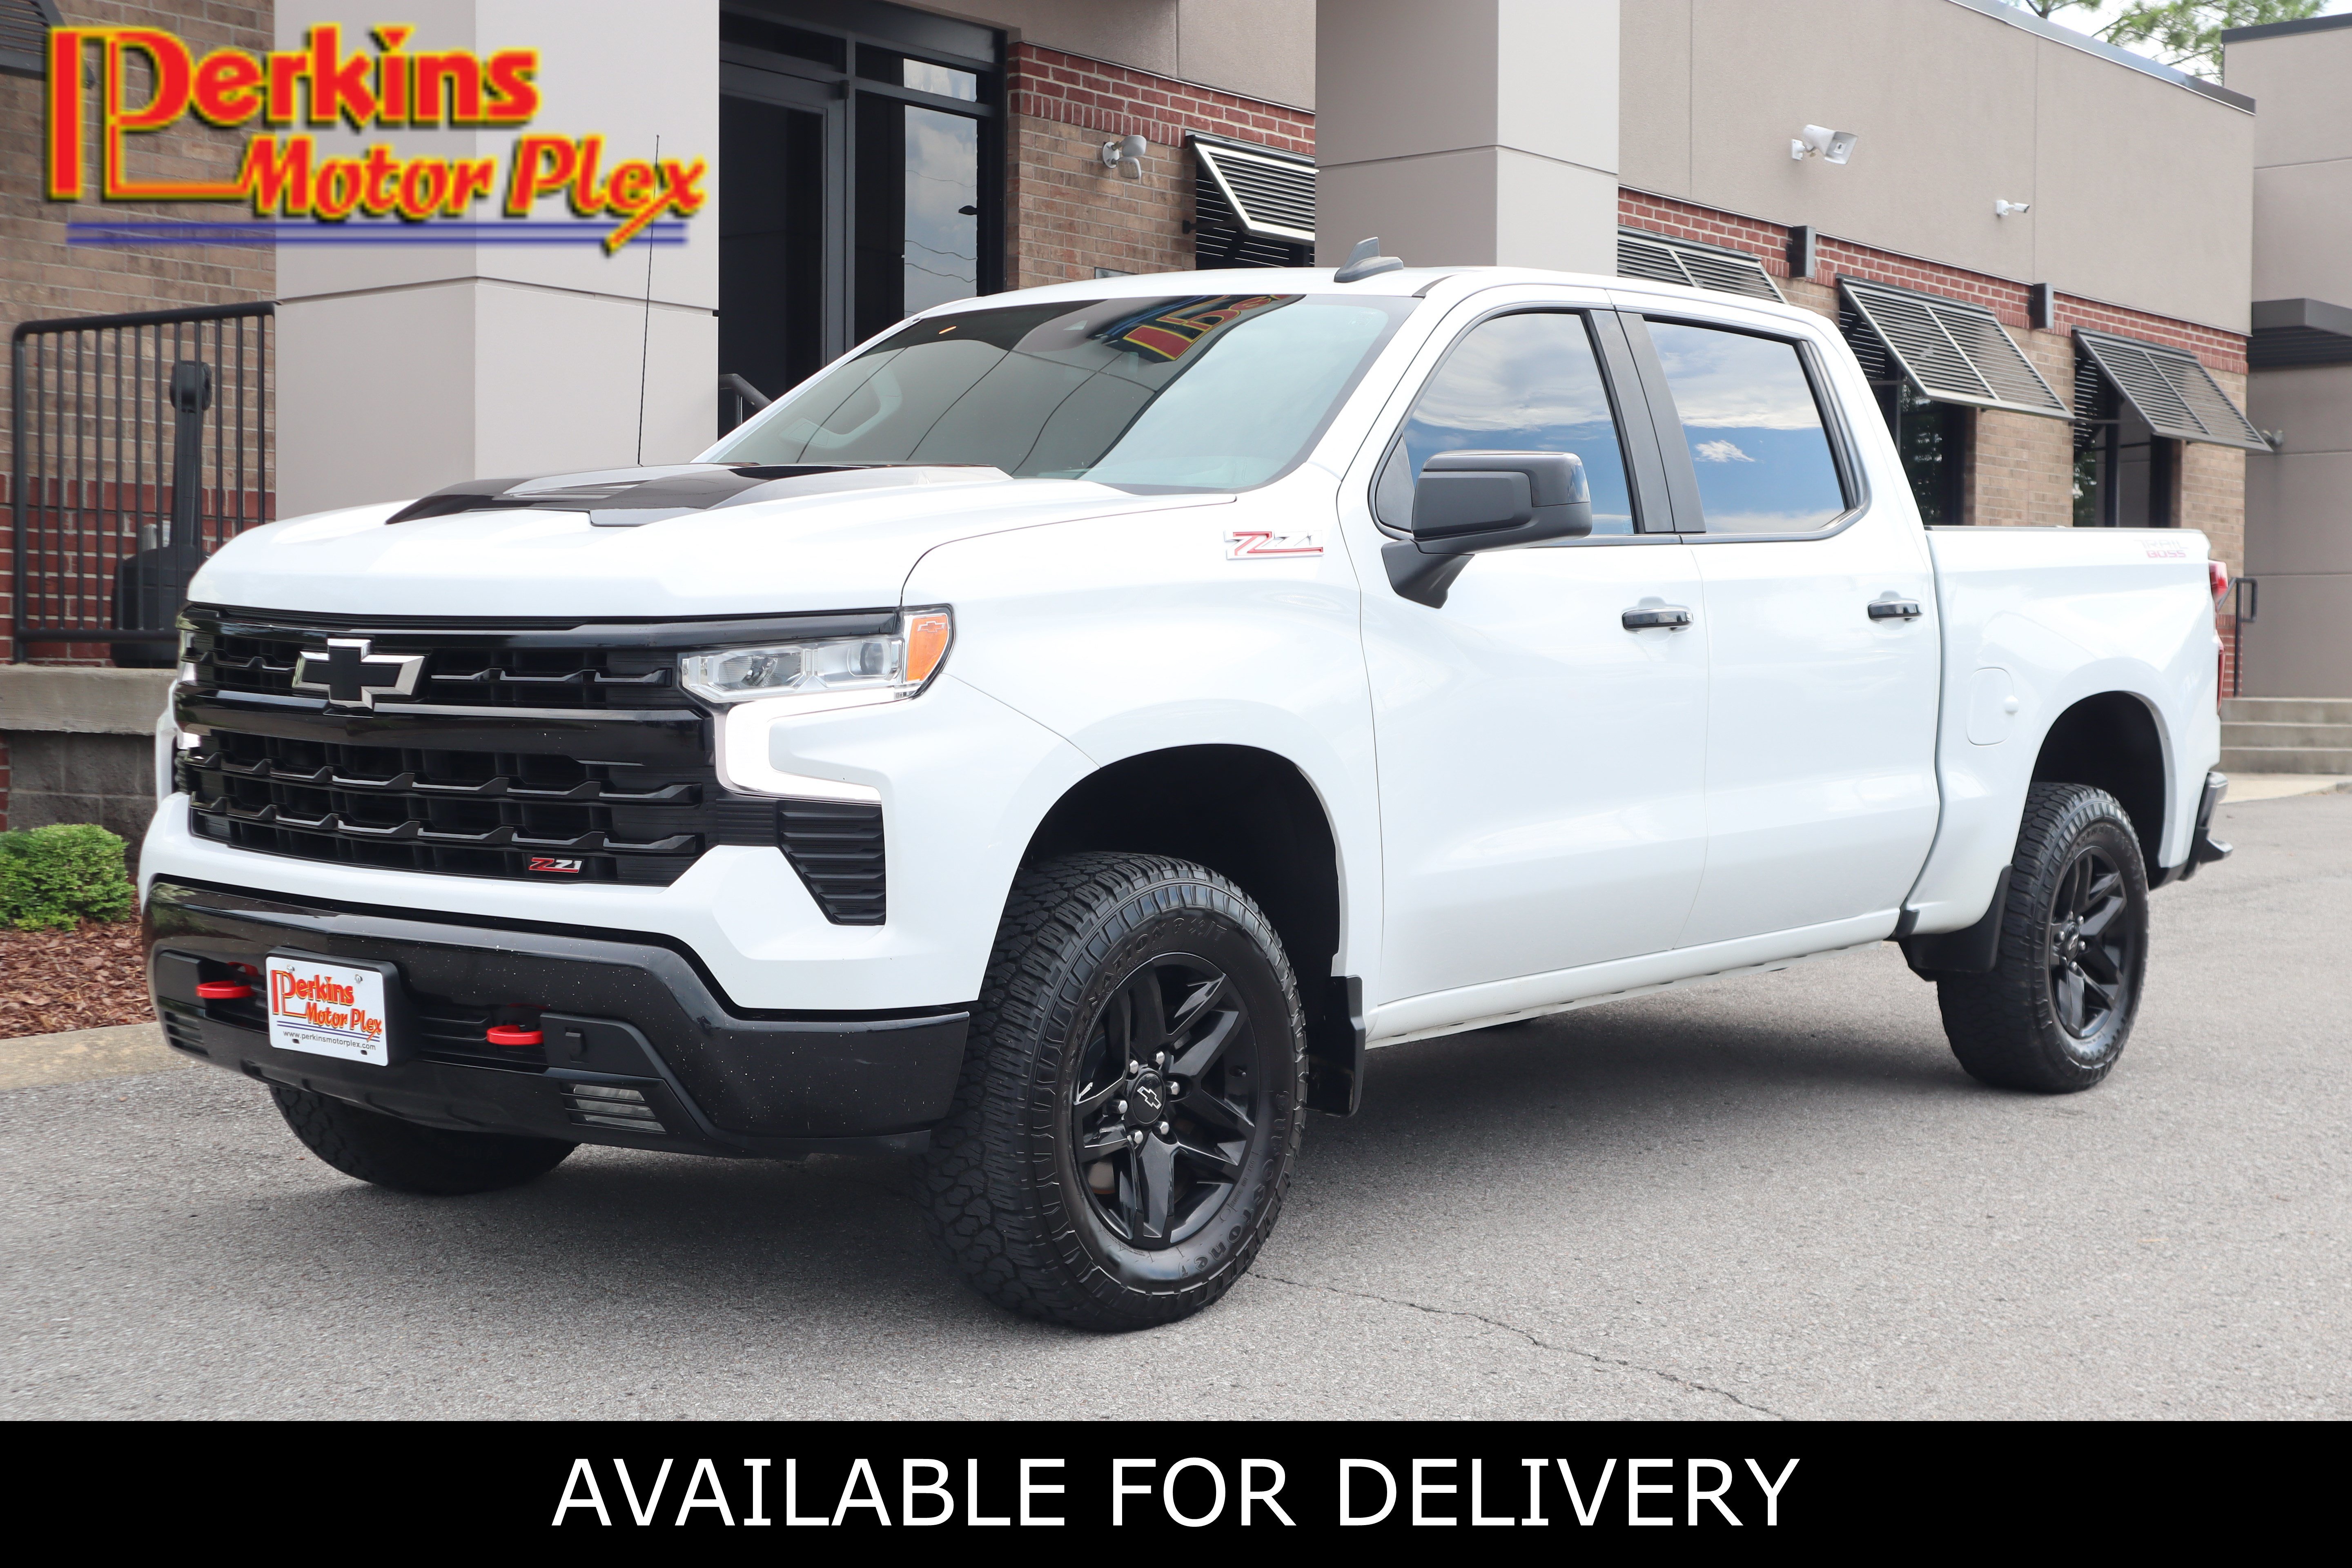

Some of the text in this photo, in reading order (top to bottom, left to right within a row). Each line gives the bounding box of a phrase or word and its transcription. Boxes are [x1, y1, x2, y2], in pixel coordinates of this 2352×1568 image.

[2133, 539, 2189, 550] TRAIL
[2145, 550, 2187, 558] BOSS
[529, 857, 583, 873] Z71
[271, 969, 355, 1017] Perkins
[305, 1001, 382, 1041] Motor Plex
[1060, 922, 1167, 1114] DESTINATION
[283, 1031, 376, 1050] www.perkinsmotorplex.com
